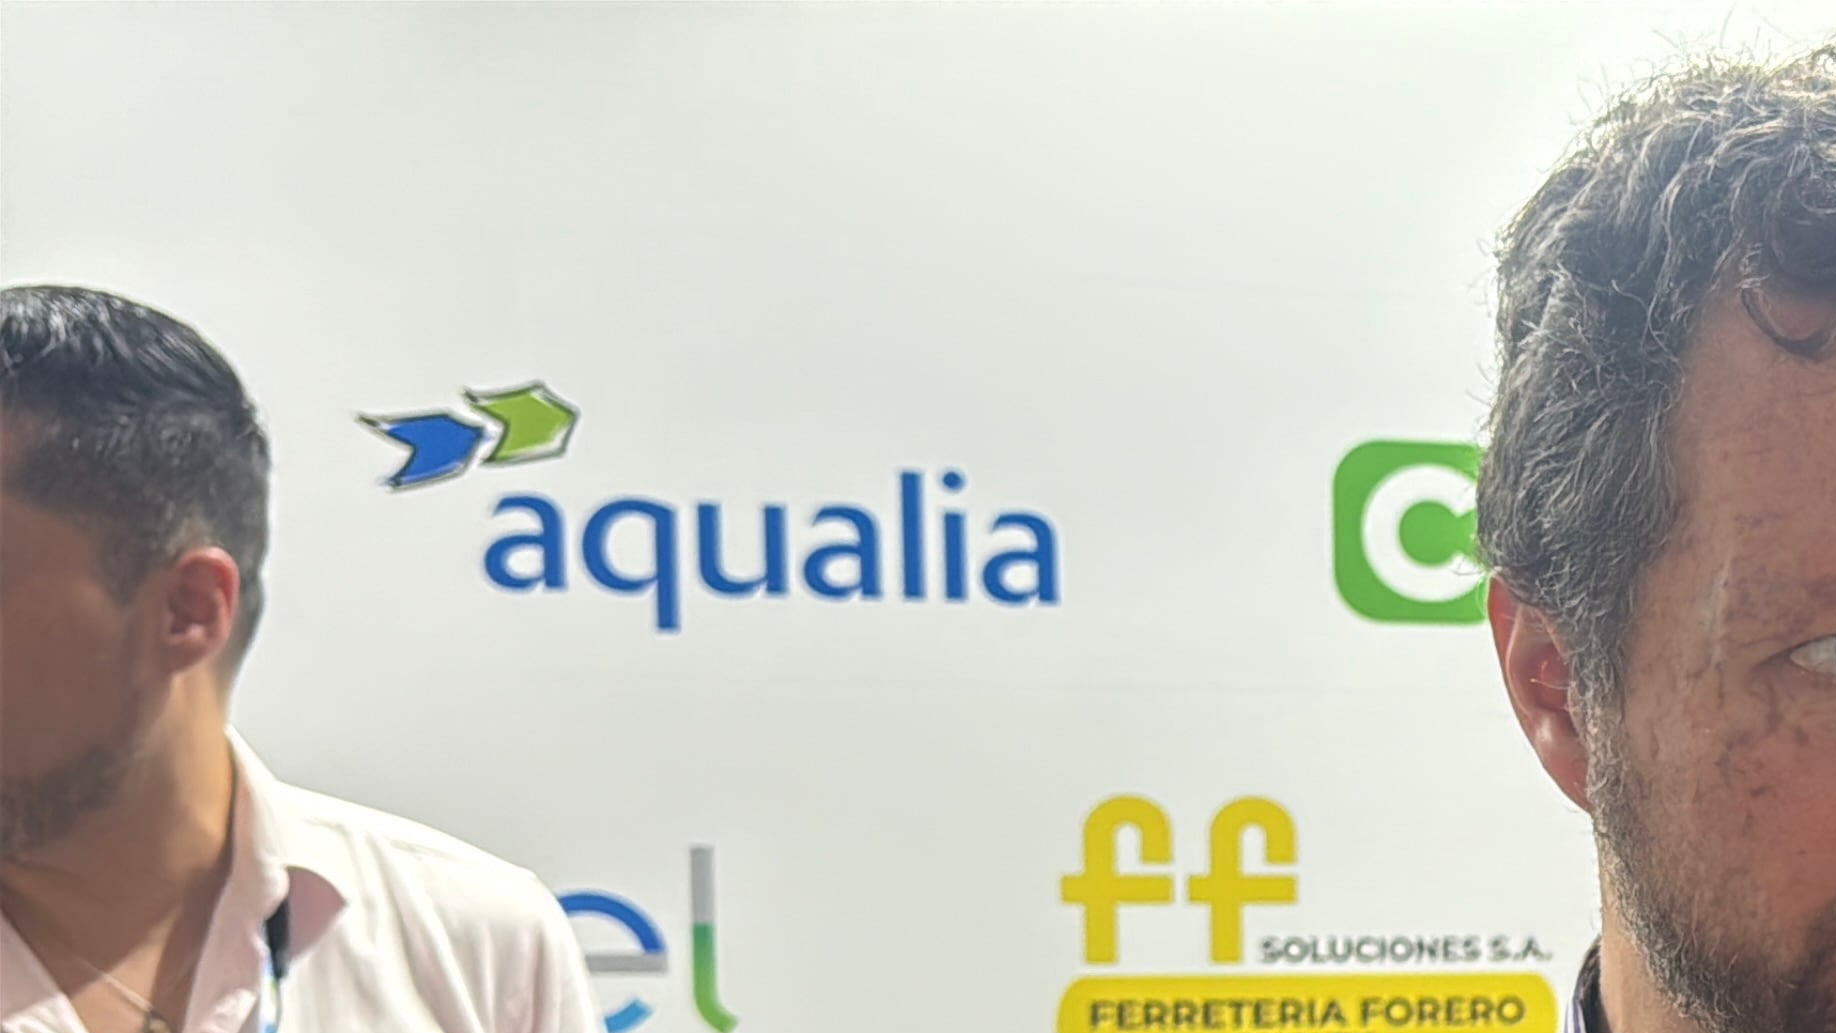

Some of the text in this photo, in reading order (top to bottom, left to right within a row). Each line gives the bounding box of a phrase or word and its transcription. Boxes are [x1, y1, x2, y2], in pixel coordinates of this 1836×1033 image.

[483, 470, 1061, 632] aqualia
[1260, 934, 1553, 964] SOLUCIONES S.A.
[1090, 994, 1527, 1031] FERRETERIA FORERO
